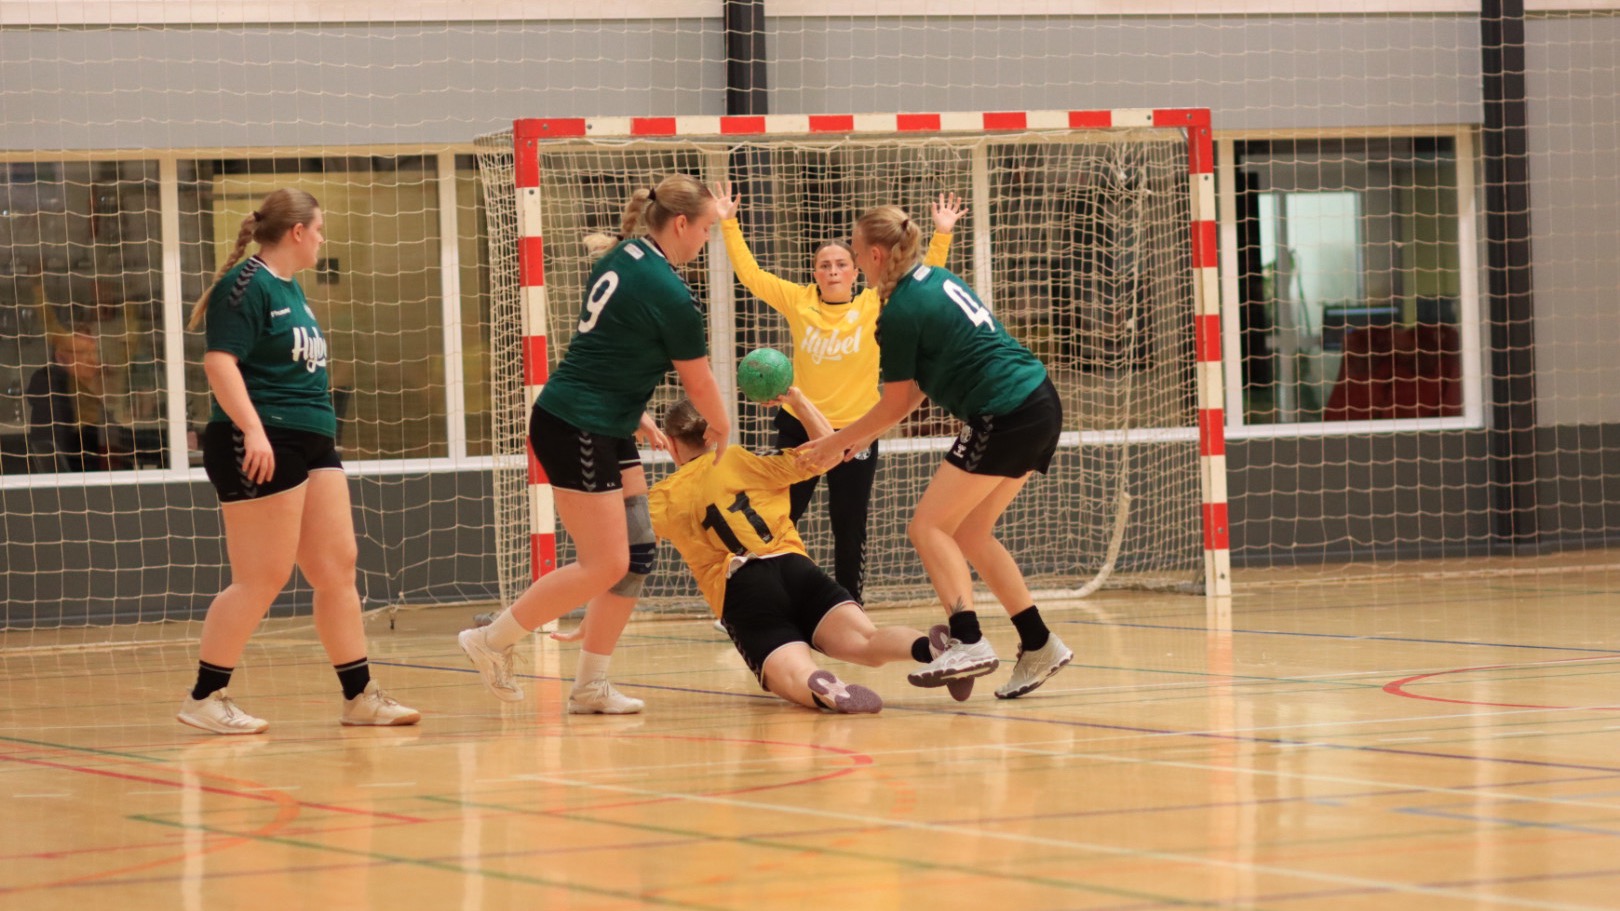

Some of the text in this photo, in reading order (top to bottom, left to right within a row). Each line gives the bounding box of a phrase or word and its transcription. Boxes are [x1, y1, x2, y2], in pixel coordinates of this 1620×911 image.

[578, 270, 619, 333] 9
[943, 279, 995, 332] 4
[801, 325, 862, 365] Hybel
[701, 490, 774, 556] 11
